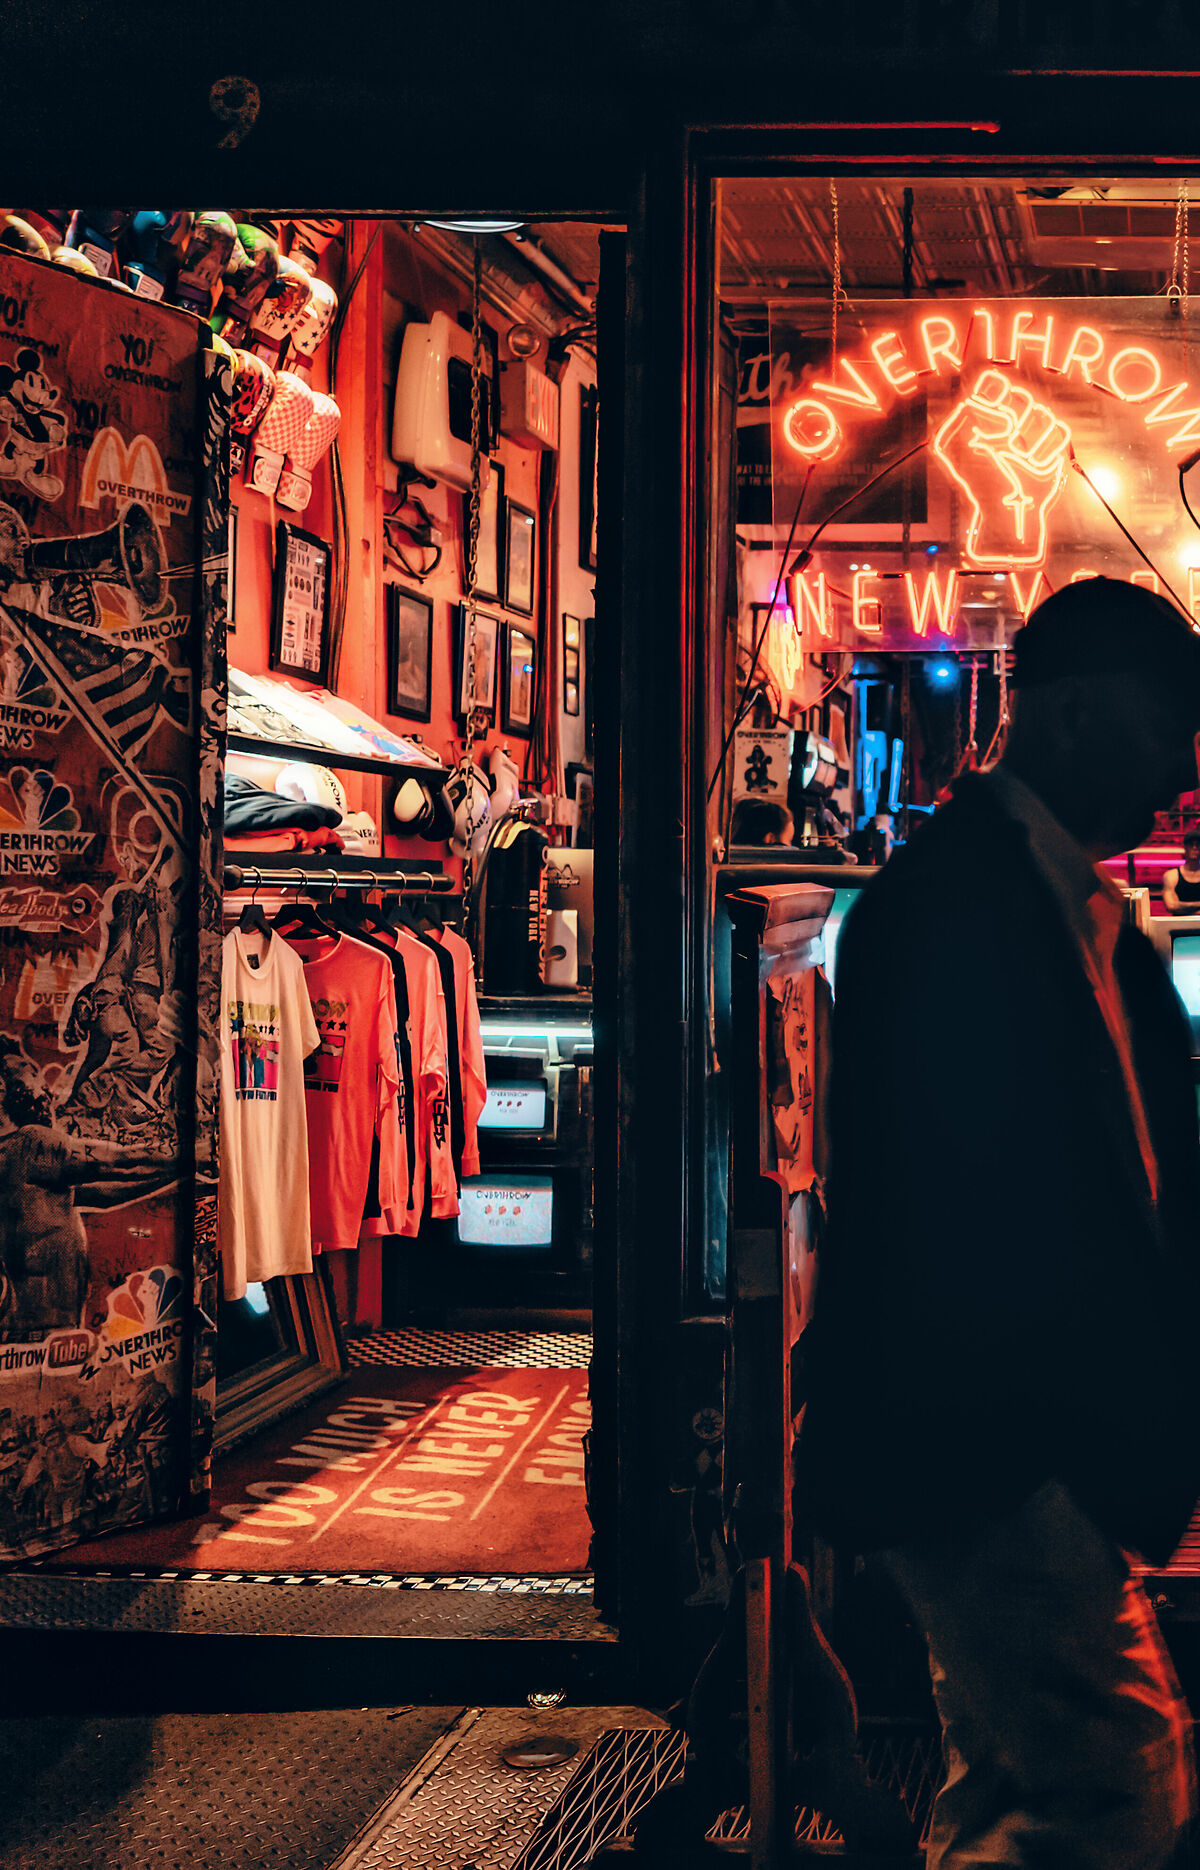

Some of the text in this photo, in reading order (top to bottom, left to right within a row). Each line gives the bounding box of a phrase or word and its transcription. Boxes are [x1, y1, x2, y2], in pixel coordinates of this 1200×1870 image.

[209, 74, 261, 149] 9
[0, 297, 28, 328] O!
[120, 333, 153, 367] YO!
[104, 364, 181, 393] OVERTHROW
[97, 479, 189, 511] OVERTHROW
[794, 570, 959, 637] NEW
[0, 832, 89, 854] ERTHROW
[4, 854, 58, 874] NEWS
[528, 889, 539, 942] NEW YORK
[52, 1339, 88, 1363] Tube
[100, 1320, 187, 1362] OVERTHRO
[129, 1342, 177, 1375] NEWS
[275, 1396, 427, 1474] MUCH
[352, 1391, 542, 1522] IS NEVER
